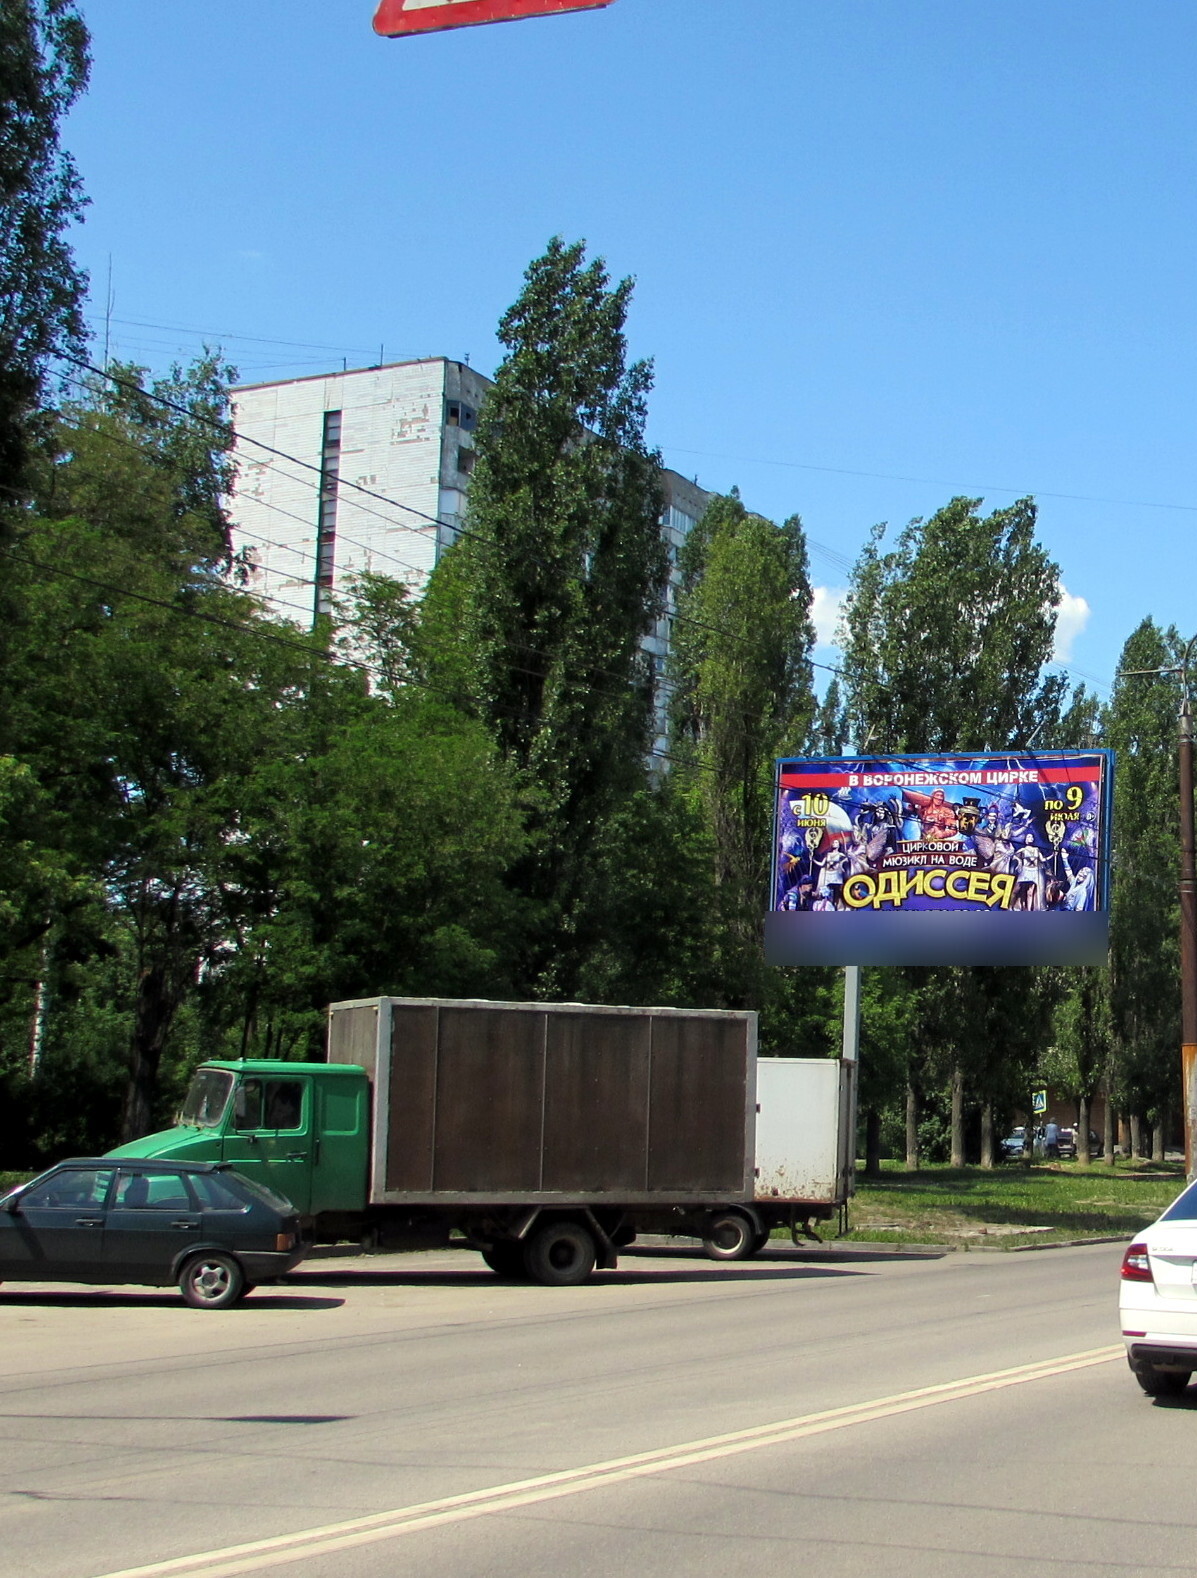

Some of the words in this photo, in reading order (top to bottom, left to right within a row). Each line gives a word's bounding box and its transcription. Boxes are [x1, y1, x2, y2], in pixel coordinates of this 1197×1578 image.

[849, 774, 859, 786] В
[863, 770, 982, 786] ВОРОНЕЖСКОМ
[986, 770, 1039, 785] ЦИРКЕ
[802, 793, 829, 816] 10
[1066, 786, 1083, 811] 9
[903, 841, 959, 853] ЦИРКОВОЙ
[882, 856, 927, 867] МЮЗИКЛ
[930, 855, 945, 865] НА
[949, 855, 977, 867] ВОДЕ
[843, 869, 1016, 909] ОДИССЕЯ
